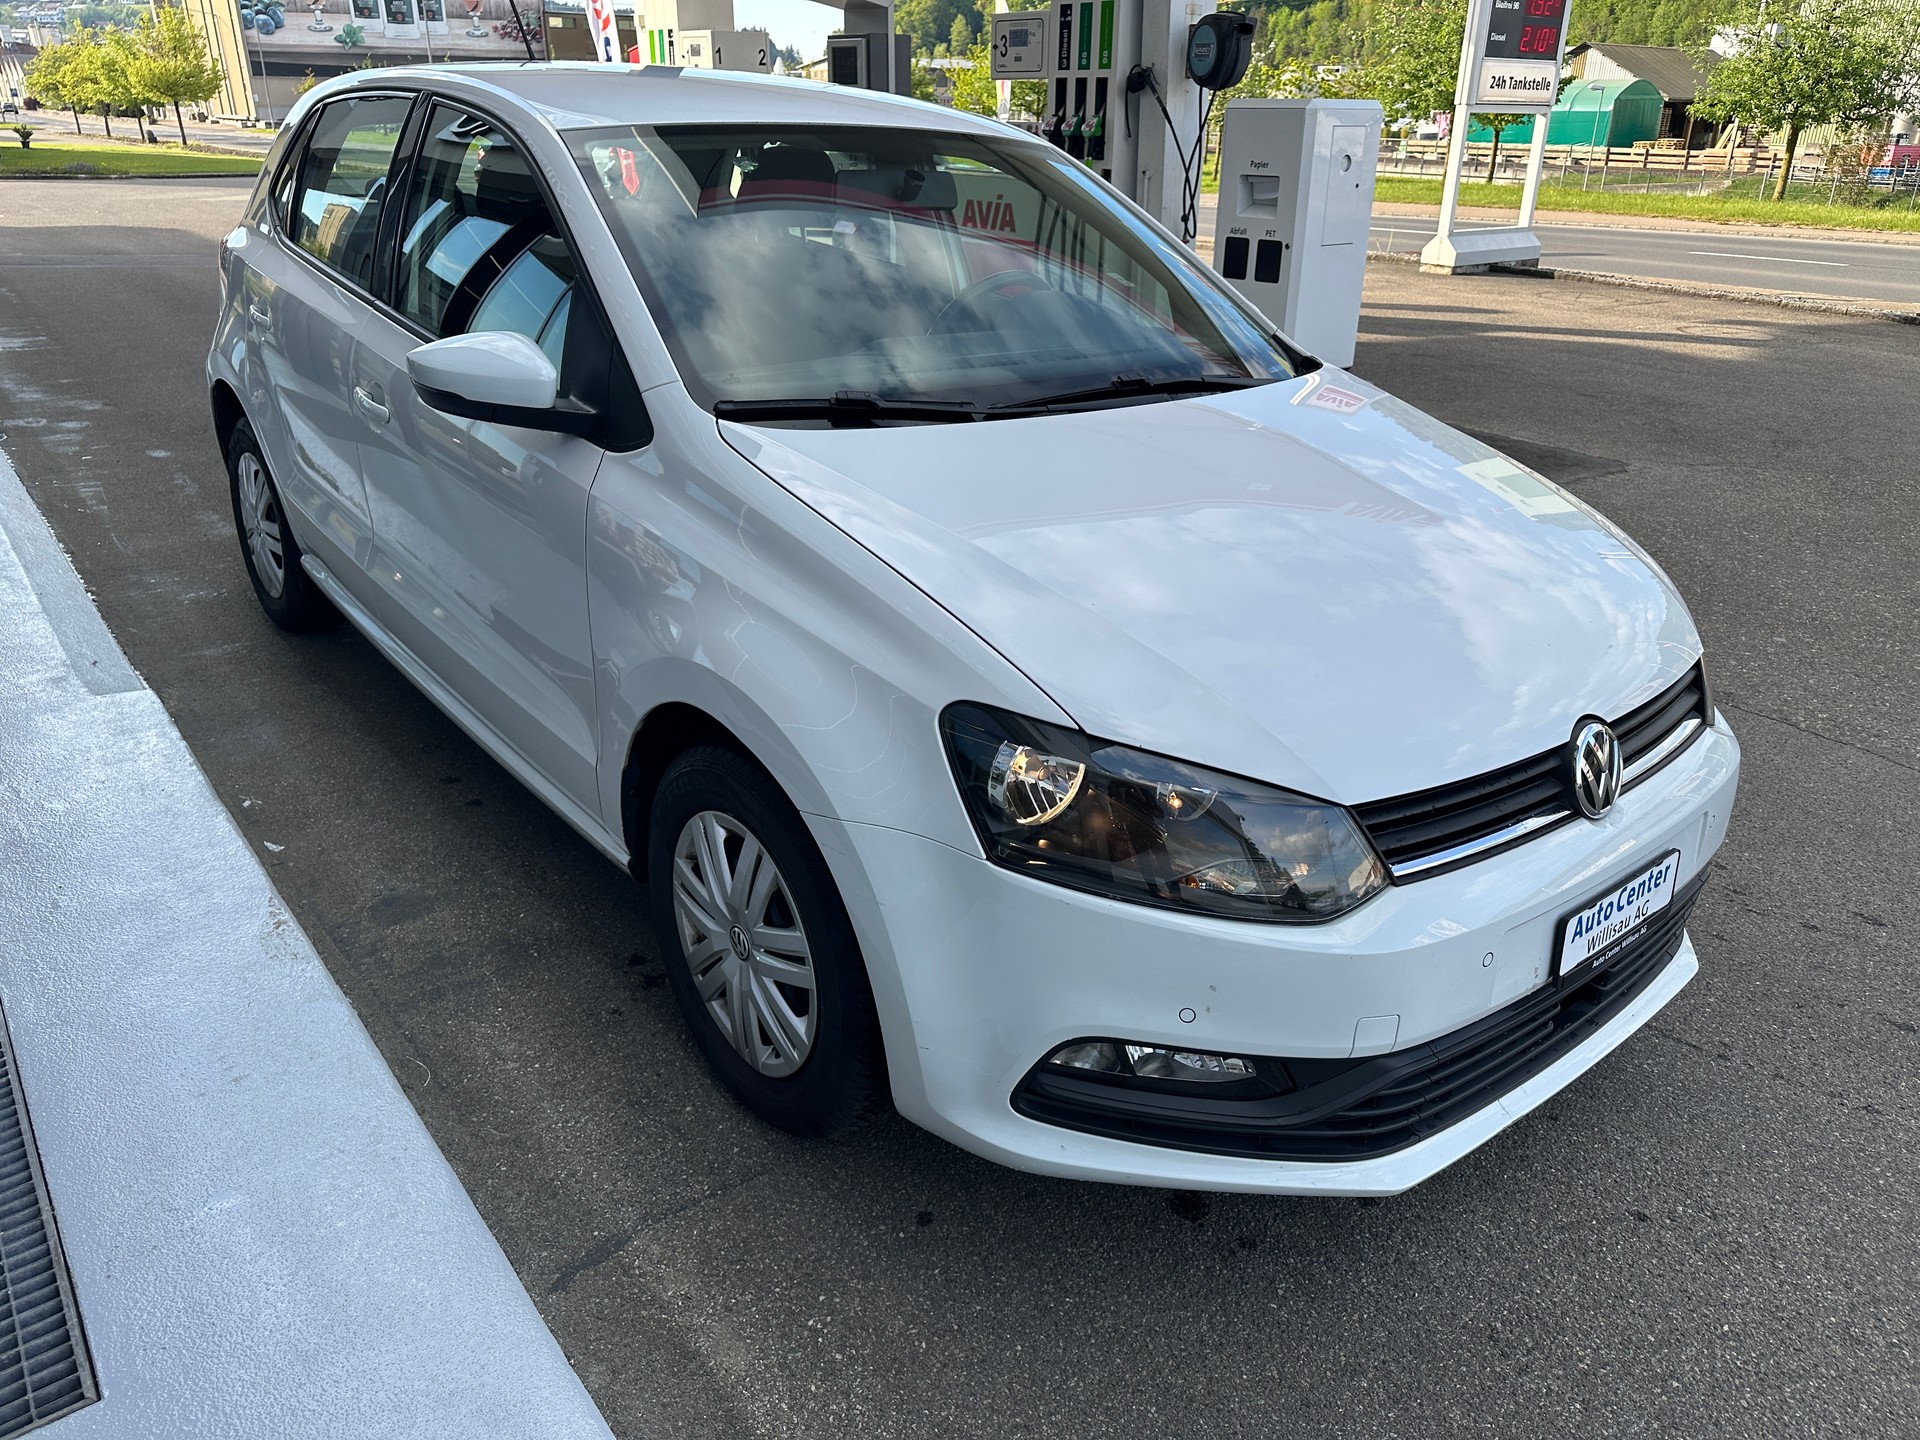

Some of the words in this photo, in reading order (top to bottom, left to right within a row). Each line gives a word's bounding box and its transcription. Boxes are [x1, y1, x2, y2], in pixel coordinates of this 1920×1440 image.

[1000, 34, 1008, 57] 3
[1061, 29, 1069, 58] Diesel
[1490, 33, 1506, 41] Diesel
[715, 47, 722, 65] 1
[758, 49, 767, 66] 2
[1490, 75, 1506, 90] 24h
[1508, 76, 1551, 91] Tankstelle
[1250, 160, 1269, 170] Papier
[1229, 227, 1247, 235] Abfall
[1265, 229, 1276, 237] PET
[1586, 915, 1631, 954] Willisau
[1633, 899, 1650, 923] AG
[1592, 956, 1605, 968] Auto
[1605, 945, 1621, 960] Center
[1621, 932, 1639, 948] Willisau
[1639, 925, 1648, 935] AG
